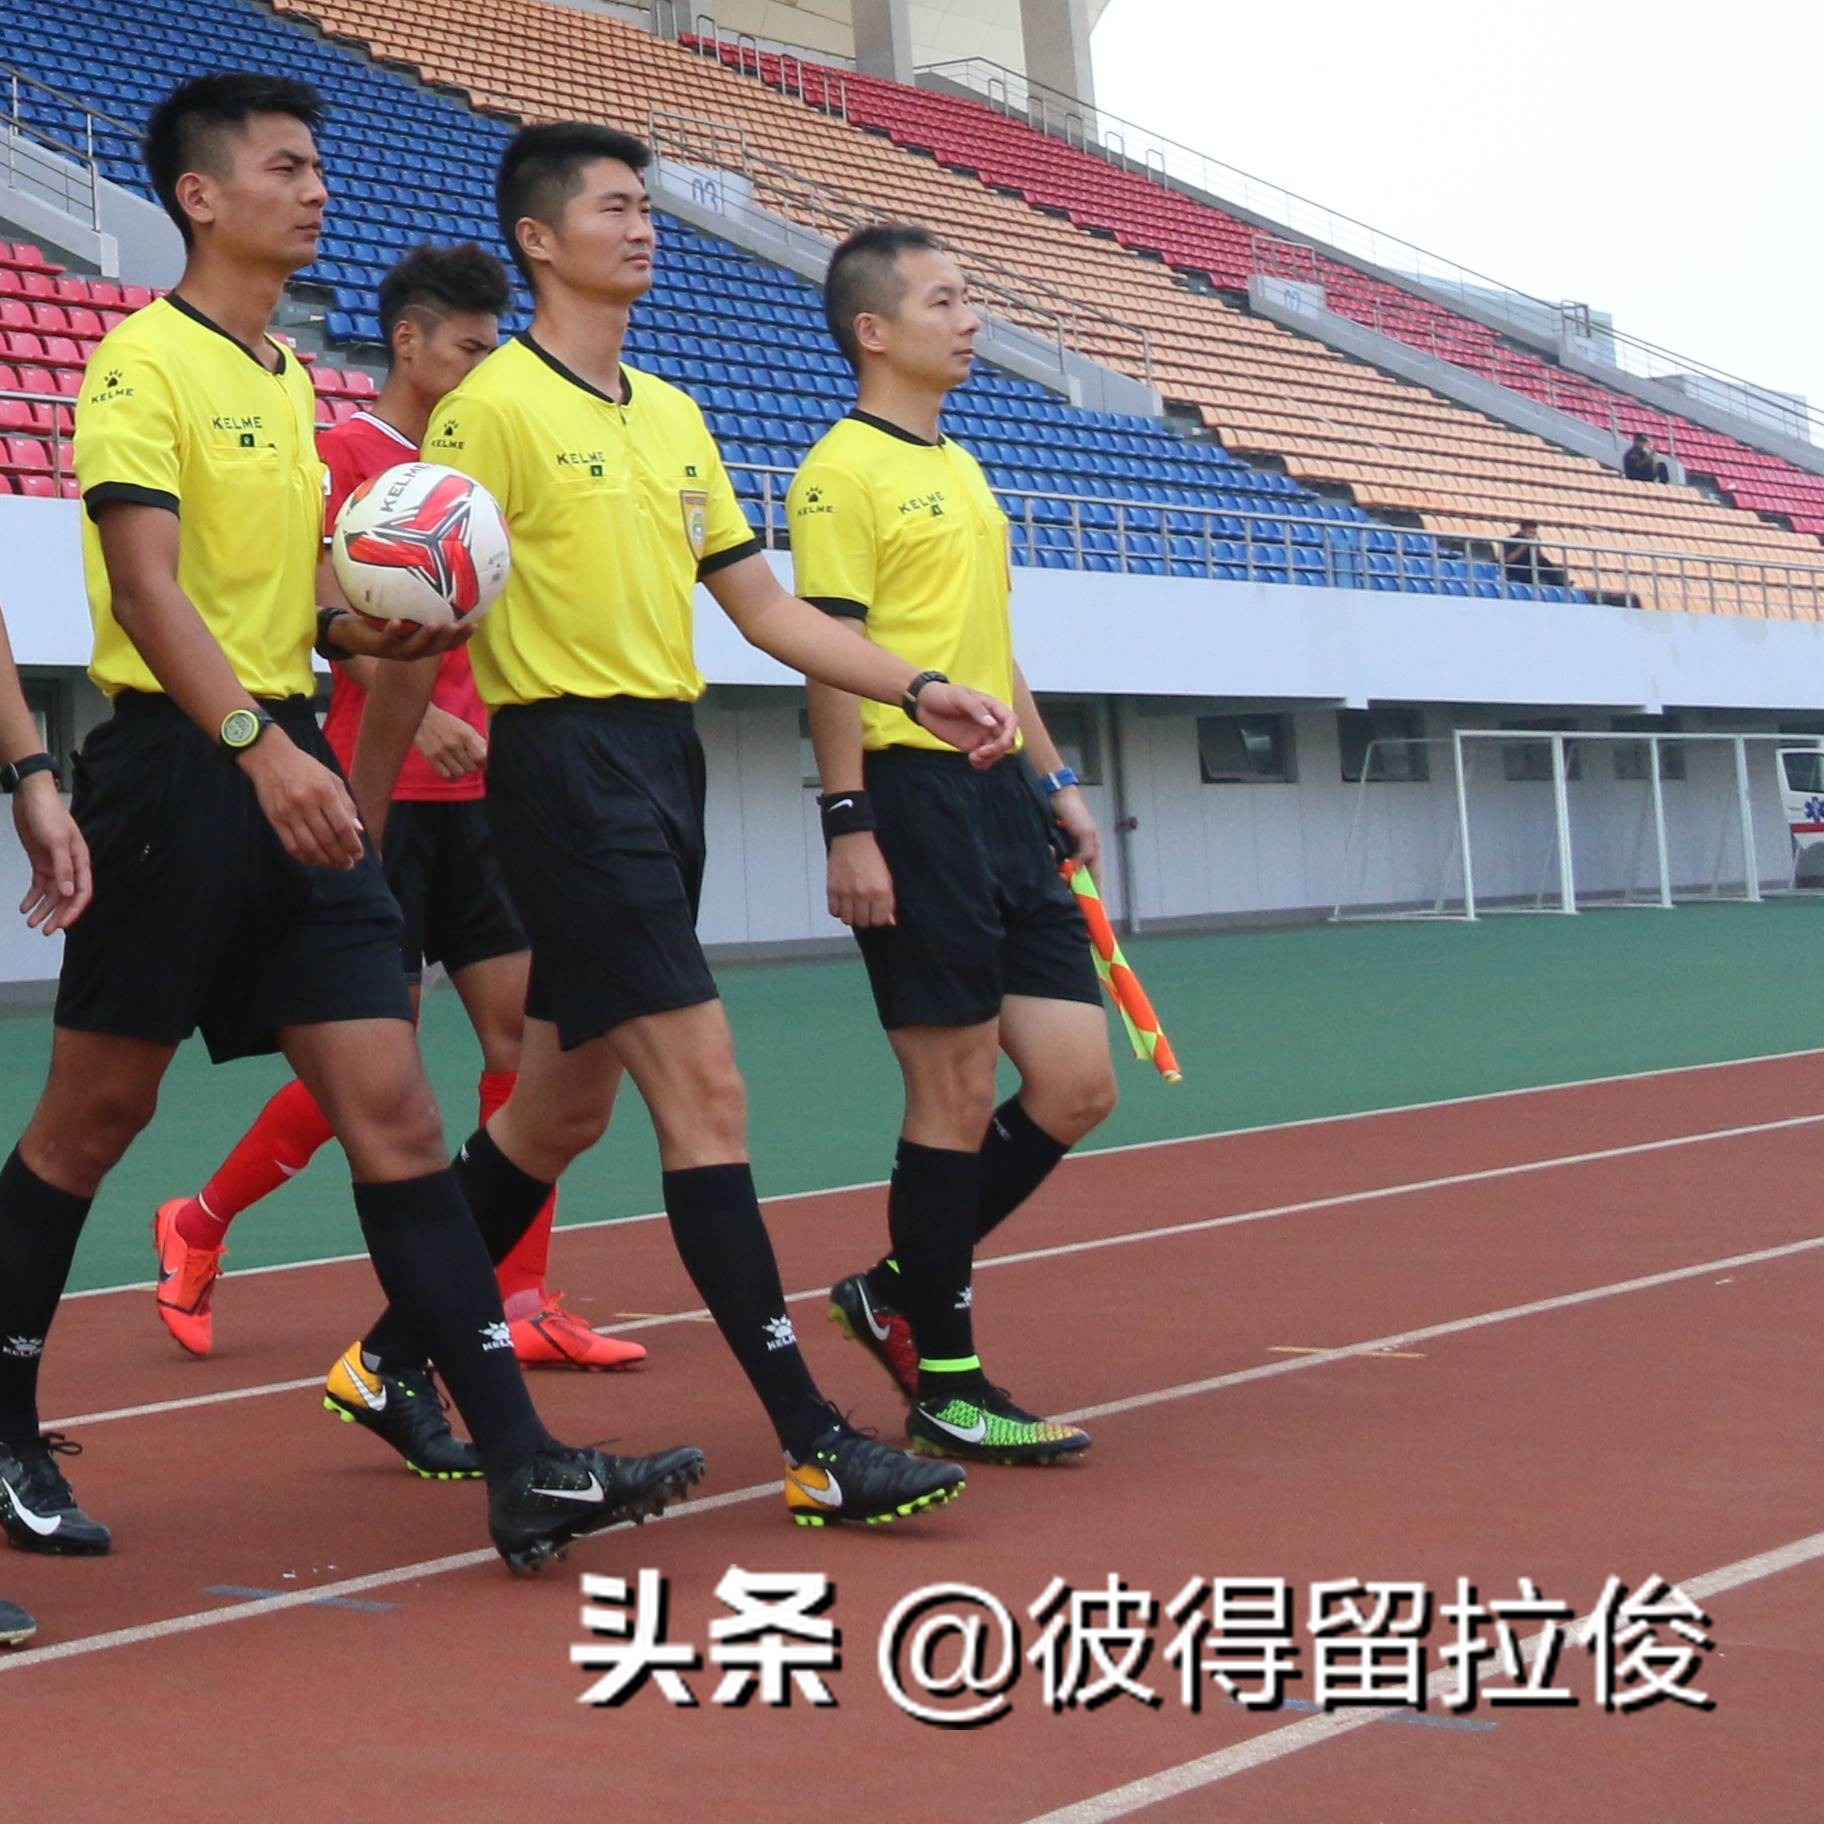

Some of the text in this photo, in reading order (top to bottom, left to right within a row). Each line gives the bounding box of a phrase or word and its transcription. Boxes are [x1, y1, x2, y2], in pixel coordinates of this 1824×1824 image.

[90, 387, 135, 405] KELME
[211, 415, 263, 431] KELME
[431, 437, 466, 451] KELME
[556, 450, 606, 466] KELME
[797, 504, 834, 518] KELME
[898, 490, 945, 516] KELME
